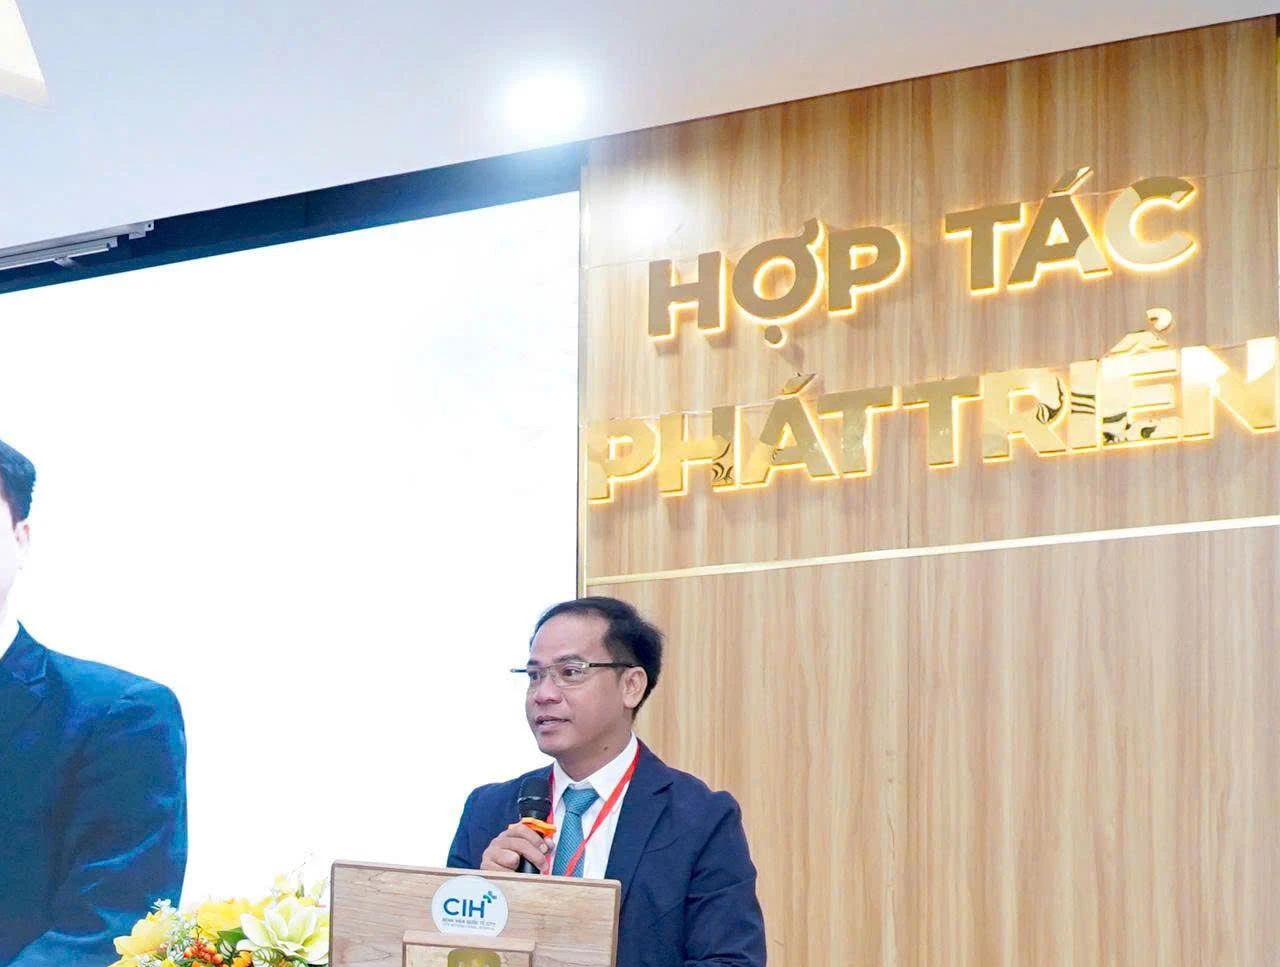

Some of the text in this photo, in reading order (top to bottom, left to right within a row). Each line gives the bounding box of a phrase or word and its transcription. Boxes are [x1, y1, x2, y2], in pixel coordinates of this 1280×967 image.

[647, 166, 1198, 348] HỢP TÁC
[586, 307, 1279, 504] PHÁT TRIỂN
[443, 897, 485, 919] CIH
